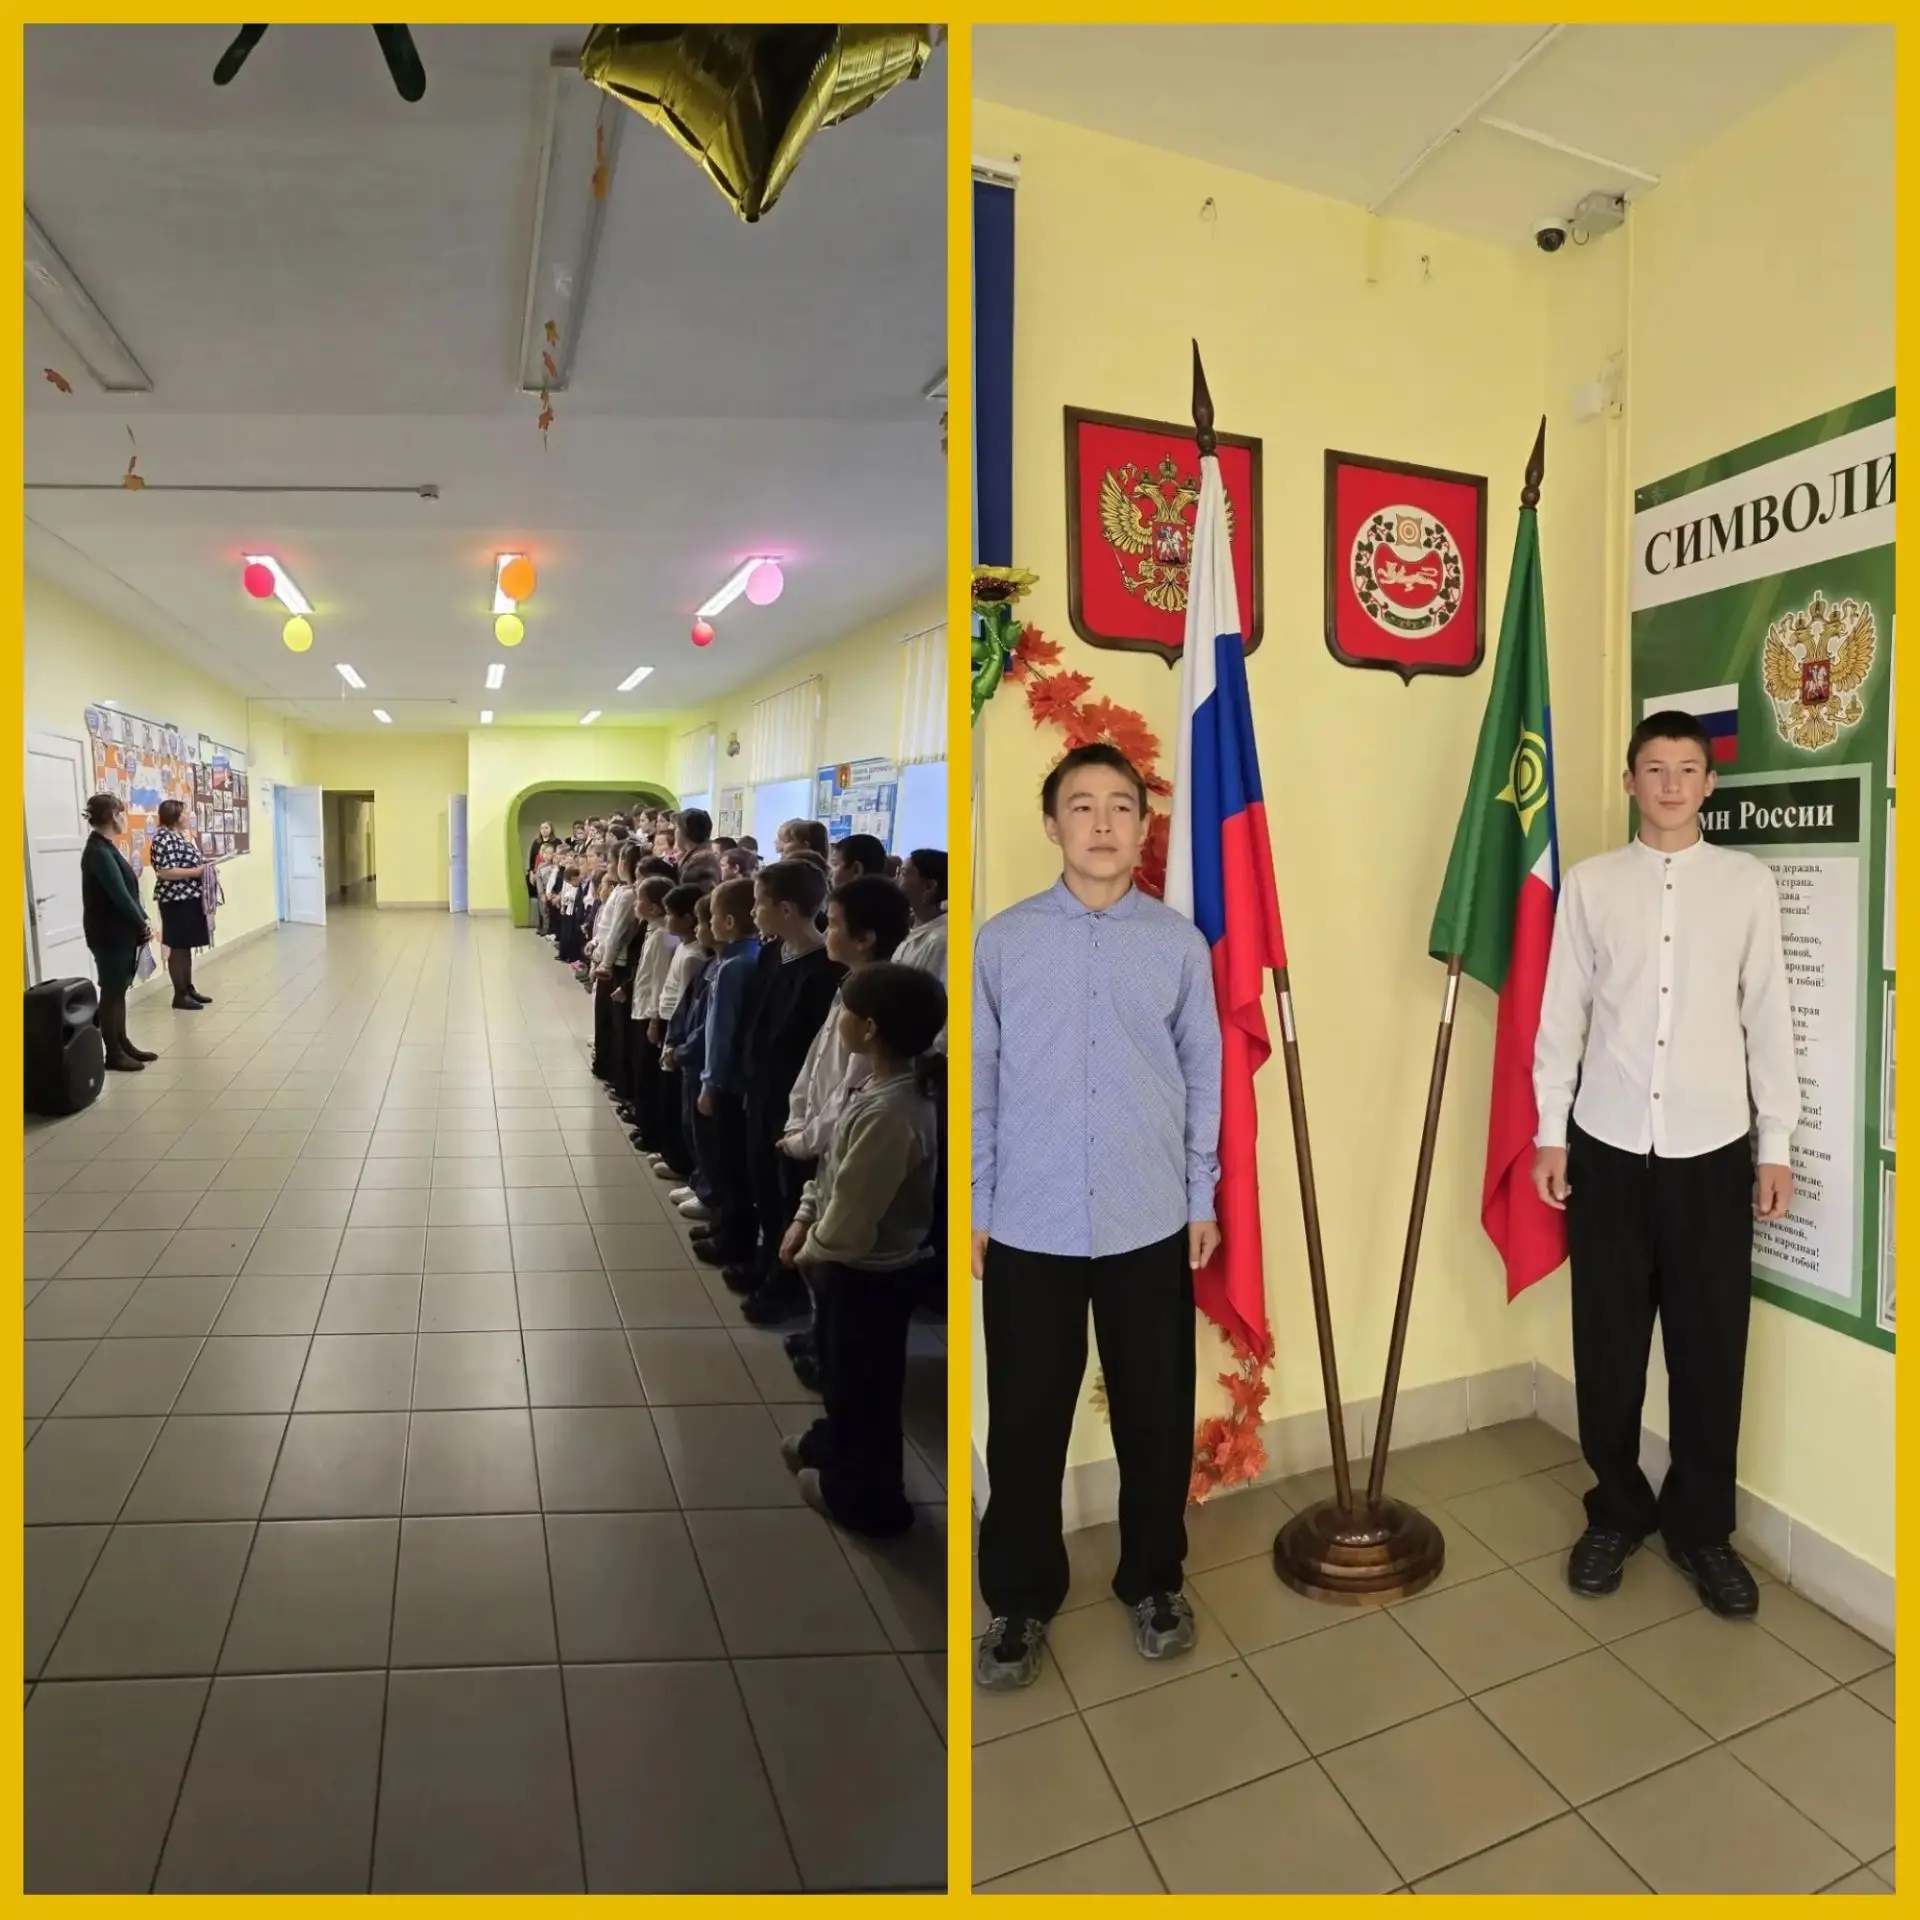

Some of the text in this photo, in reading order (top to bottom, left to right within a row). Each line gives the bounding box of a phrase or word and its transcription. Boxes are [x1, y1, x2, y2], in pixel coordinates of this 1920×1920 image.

[1645, 452, 1896, 575] СИМВОЛИ
[1698, 801, 1835, 831] мн России
[1779, 893, 1800, 901] лава
[1780, 905, 1810, 915] емена!
[1785, 963, 1825, 973] ародная!
[1797, 1116, 1822, 1130] обой!
[1790, 1172, 1824, 1188] тчизне.
[1794, 1187, 1821, 1201] сегда!
[1784, 1209, 1817, 1230] бодное,
[1753, 1243, 1789, 1261] ордимся
